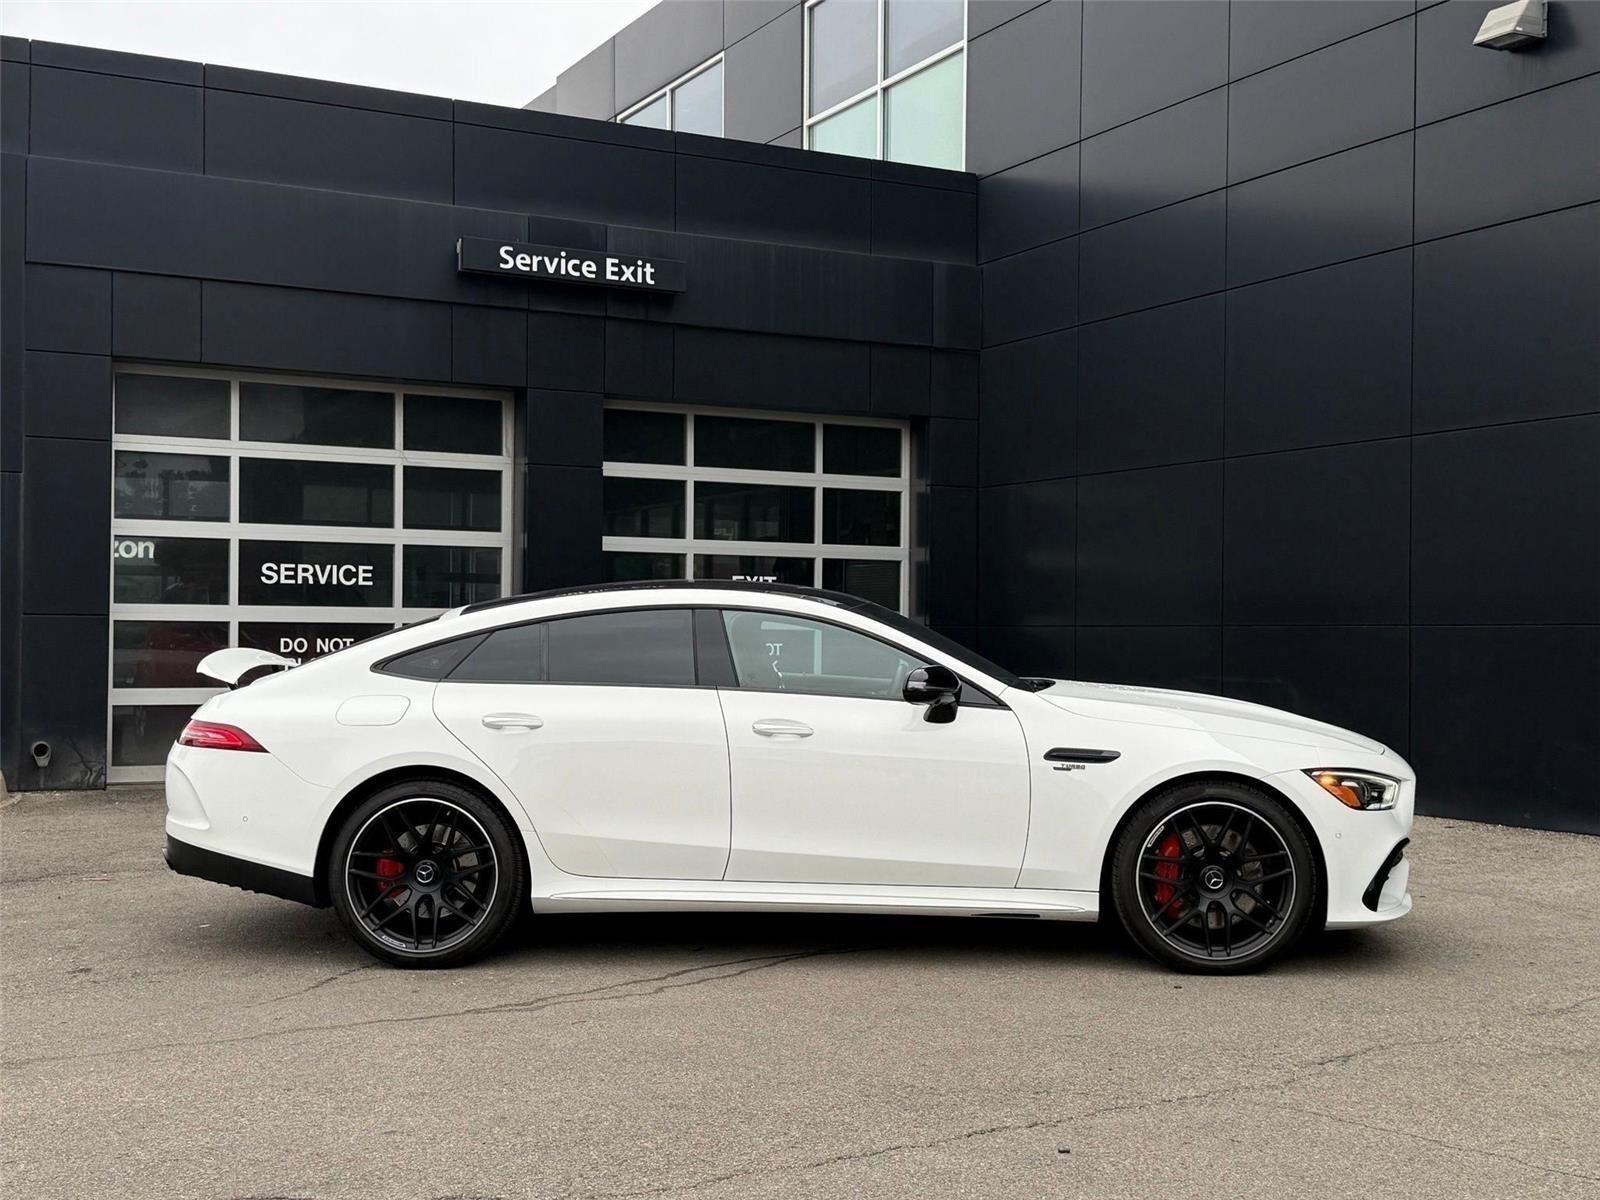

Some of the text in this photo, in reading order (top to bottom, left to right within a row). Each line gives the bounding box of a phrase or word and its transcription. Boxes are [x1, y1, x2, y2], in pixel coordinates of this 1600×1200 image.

[499, 245, 655, 285] Service Exit
[260, 562, 374, 586] SERVICE
[280, 637, 308, 653] DO
